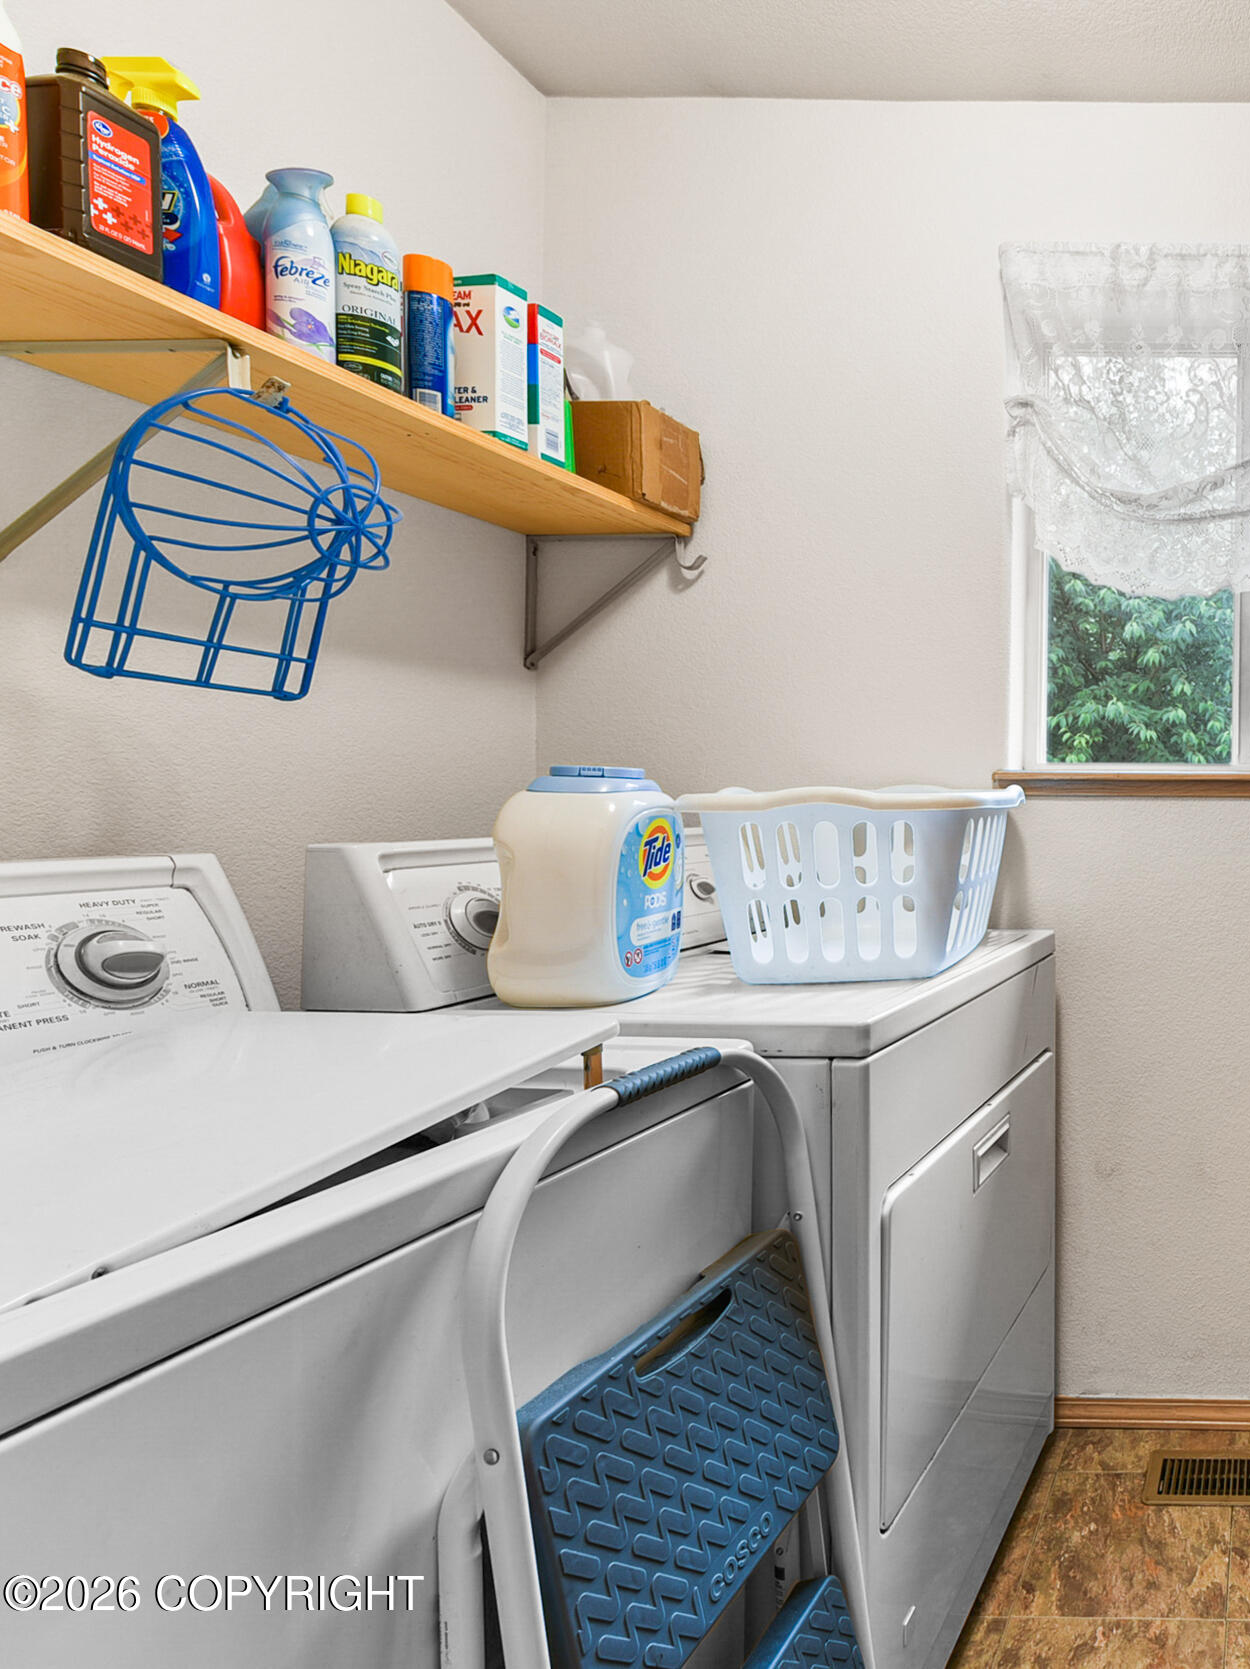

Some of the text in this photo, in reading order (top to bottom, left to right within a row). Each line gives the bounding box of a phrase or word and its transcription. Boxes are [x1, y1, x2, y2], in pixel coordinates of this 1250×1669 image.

[92, 134, 140, 165] Hydrogen
[92, 143, 135, 171] Peroxide
[273, 255, 330, 288] febreze
[337, 251, 399, 292] Niagara
[453, 290, 472, 300] EAM
[454, 395, 489, 404] LEANER
[643, 834, 672, 878] Tide
[79, 898, 136, 909] HEAVY DUTY
[644, 892, 668, 911] PODS
[0, 922, 46, 933] REWASH
[11, 933, 42, 943] SOAK
[184, 979, 220, 990] NORMAL
[17, 1001, 41, 1009] SHORT
[0, 1014, 70, 1032] ANENT PRESS
[32, 1046, 51, 1054] PUSH
[710, 1511, 774, 1603] COSCO
